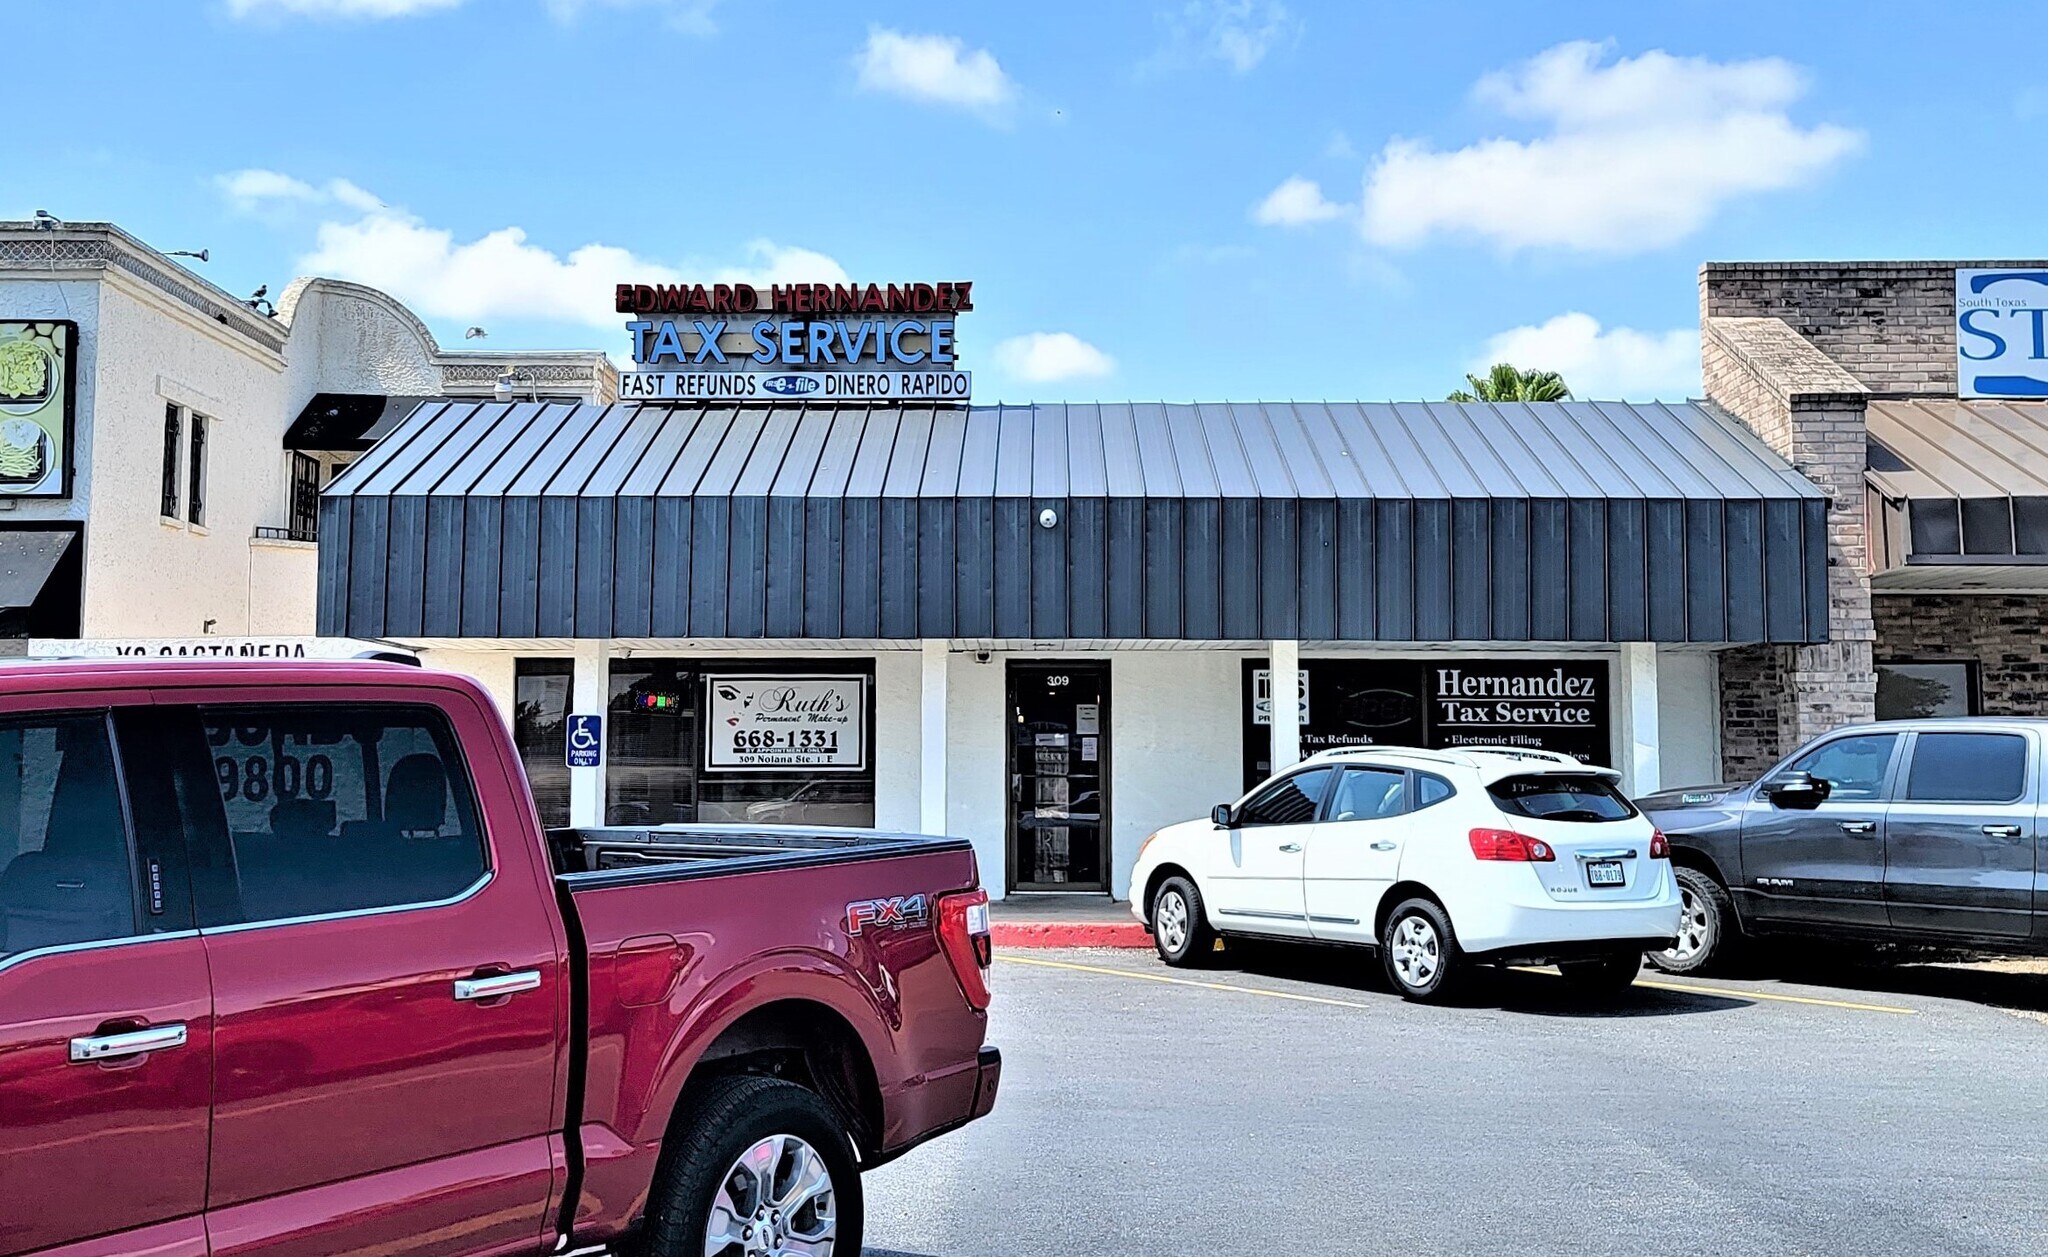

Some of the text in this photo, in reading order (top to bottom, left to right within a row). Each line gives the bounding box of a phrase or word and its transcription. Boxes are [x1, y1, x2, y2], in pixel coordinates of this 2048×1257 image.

[616, 281, 974, 312] EDWARD HERNANDEZ
[1958, 298, 2027, 307] South Texas
[625, 319, 955, 364] TAX SERVICE
[622, 375, 666, 395] FAST
[676, 375, 756, 395] REFUNDS
[825, 374, 890, 395] DINERO
[901, 374, 968, 395] RAPIDO
[1047, 675, 1069, 686] 309
[1436, 668, 1595, 697] Hernandez
[759, 686, 850, 712] Ruth's
[1441, 701, 1591, 723] Tax Service
[755, 713, 849, 724] Permanent Make-up
[733, 729, 838, 748] 668-1331
[1305, 734, 1326, 744] Tax
[1327, 733, 1374, 744] Refunds
[1452, 735, 1543, 747] Electronic Filing
[571, 749, 597, 757] PARKING
[739, 755, 755, 763] 309
[757, 755, 793, 763] Nolana
[573, 757, 593, 765] ONLY
[1756, 877, 1794, 887] RAM
[846, 893, 929, 937] FX4
